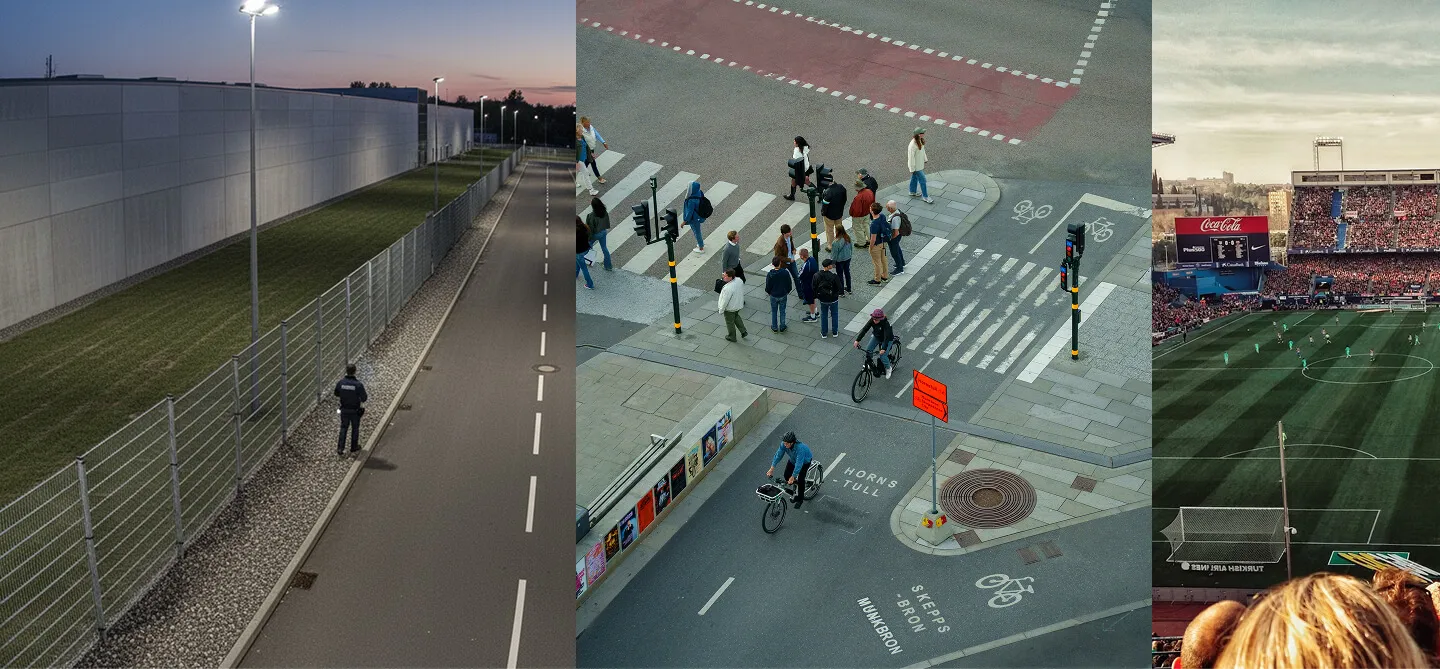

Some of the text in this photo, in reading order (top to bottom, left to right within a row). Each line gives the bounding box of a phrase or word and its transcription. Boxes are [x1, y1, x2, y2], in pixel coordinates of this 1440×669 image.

[1200, 218, 1242, 232] Coca-Cola
[843, 467, 898, 488] HORNS
[857, 597, 903, 655] MUNKBRON
[911, 585, 950, 633] SKEPPS
